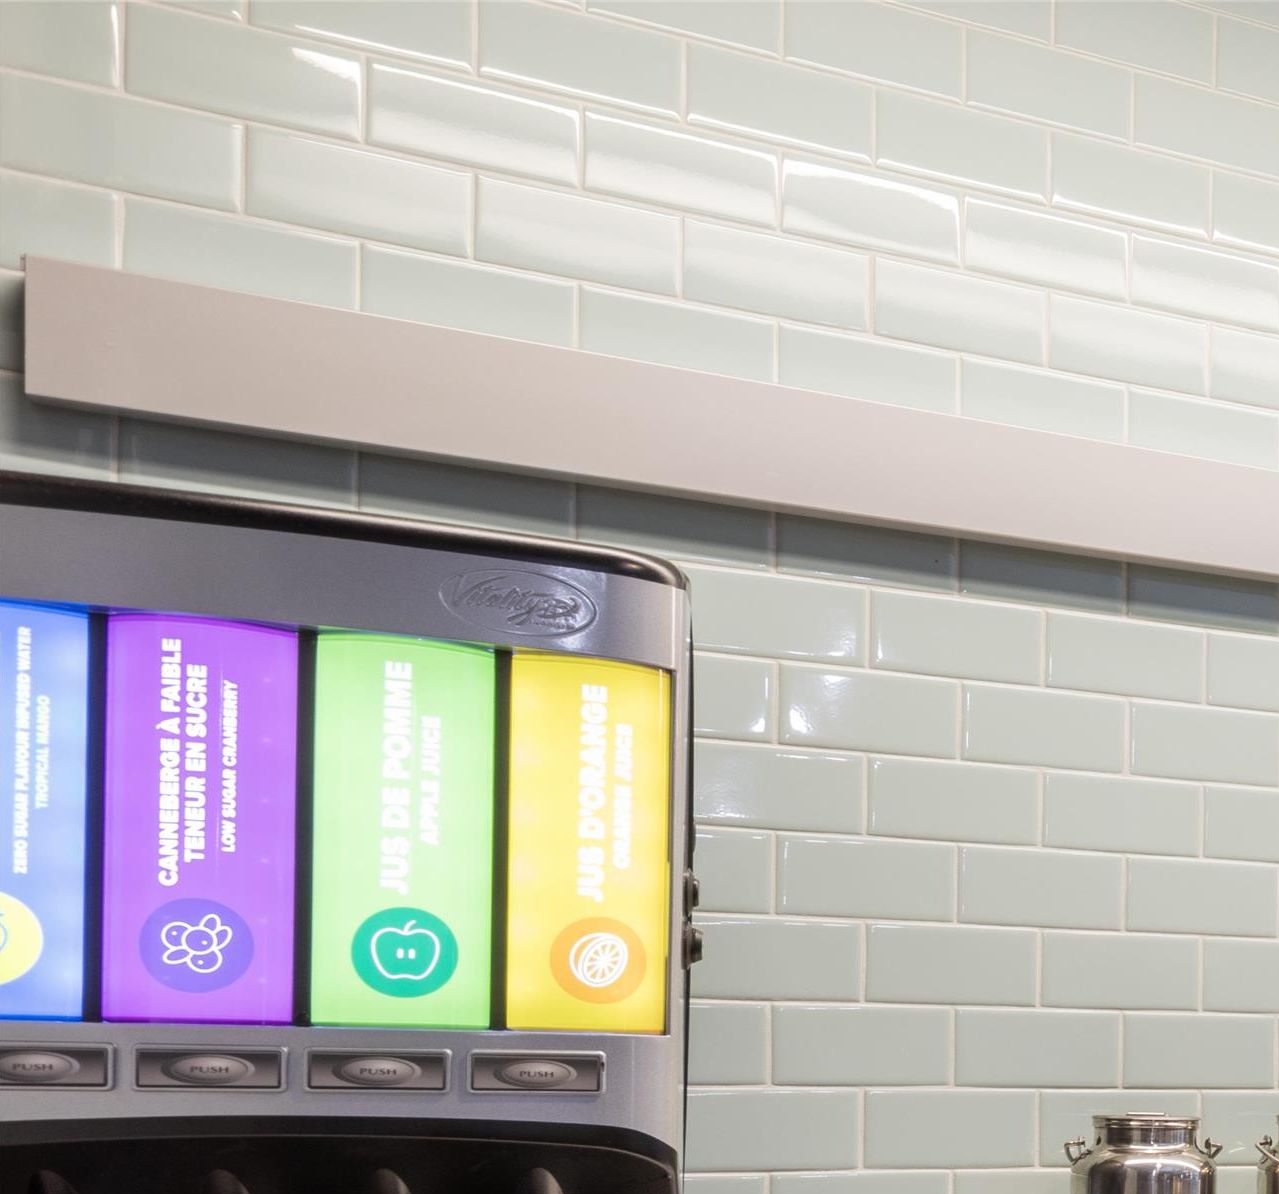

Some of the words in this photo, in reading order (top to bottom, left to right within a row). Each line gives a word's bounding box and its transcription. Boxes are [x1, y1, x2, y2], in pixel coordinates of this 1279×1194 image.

[160, 638, 182, 713] FAIBLE
[185, 663, 208, 739] SUCRE
[155, 717, 181, 735] À
[222, 679, 239, 767] CRANBERRY
[382, 660, 413, 780] POMME
[420, 715, 442, 776] JUICE
[185, 741, 207, 772] EN
[577, 683, 609, 840] D'ORANGE
[158, 737, 181, 887] CANNEBERGE
[183, 776, 206, 863] TENEUR
[221, 769, 237, 819] SUGAR
[381, 786, 411, 829] DE
[220, 820, 236, 853] LOW
[379, 836, 411, 896] JUS
[576, 846, 606, 904] JUS
[12, 1063, 54, 1071] PUSH
[190, 1065, 229, 1073] PUSH
[360, 1067, 397, 1076] PUSH
[519, 1070, 554, 1078] PUSH
